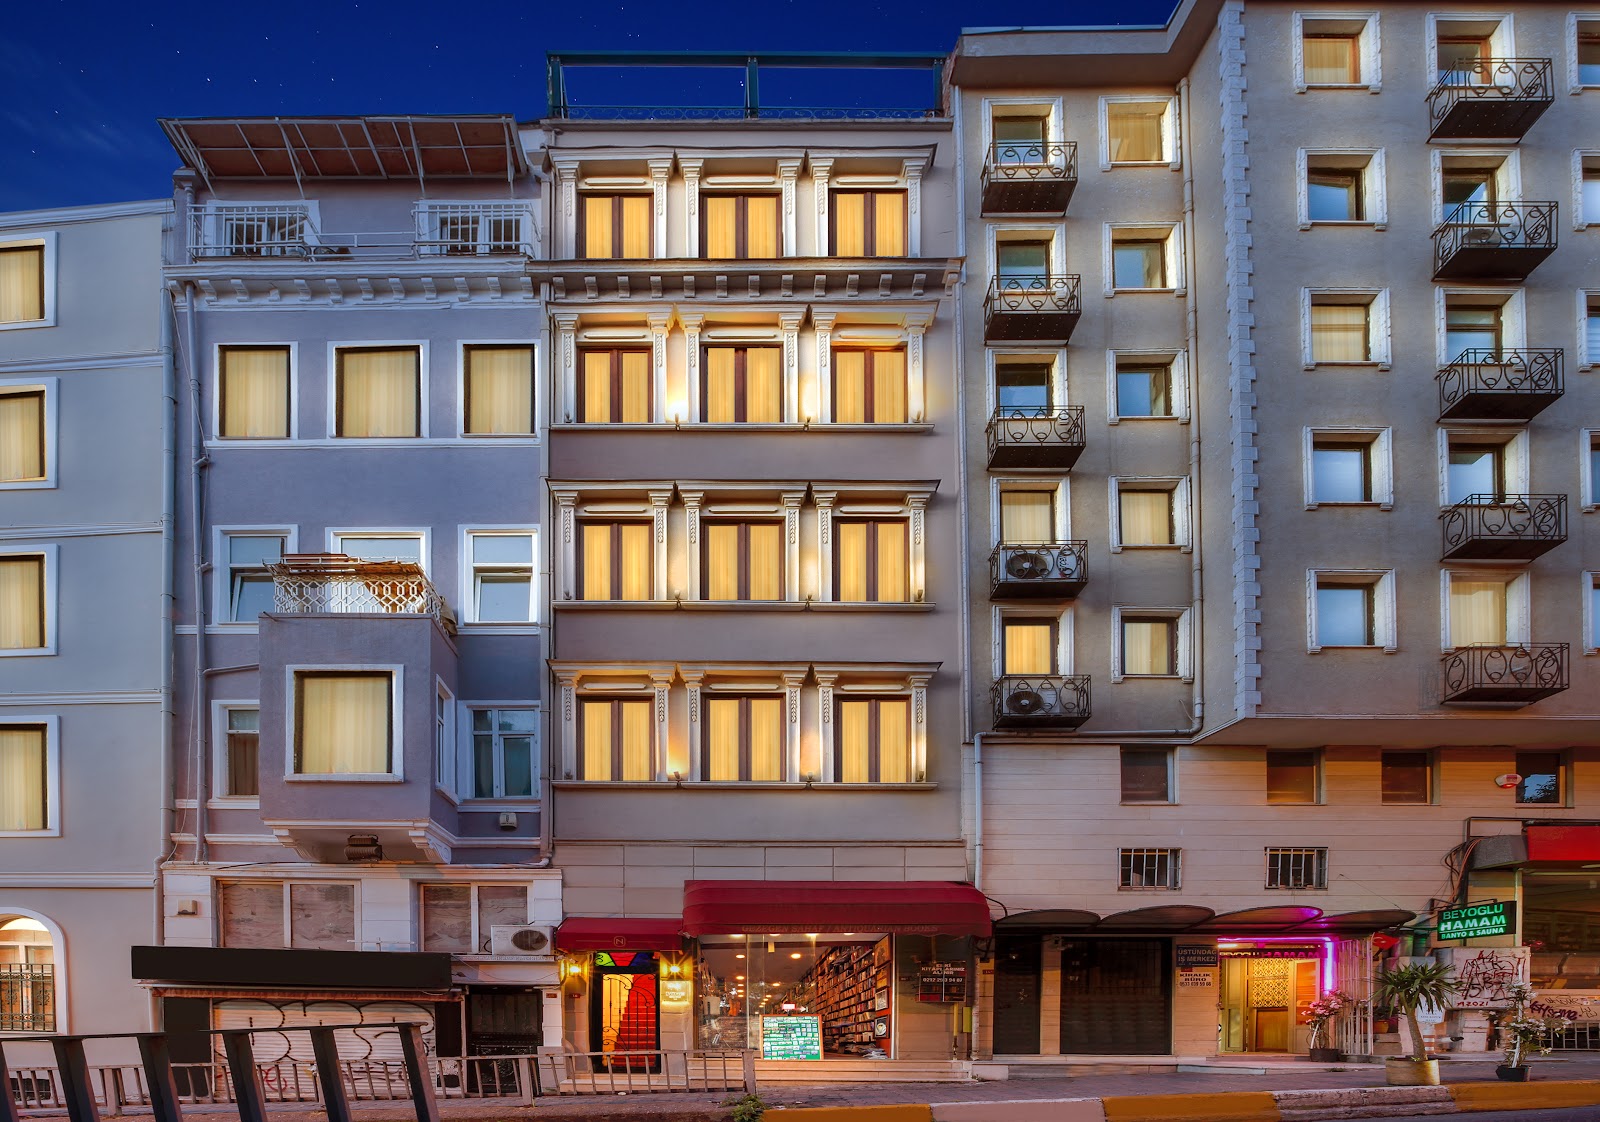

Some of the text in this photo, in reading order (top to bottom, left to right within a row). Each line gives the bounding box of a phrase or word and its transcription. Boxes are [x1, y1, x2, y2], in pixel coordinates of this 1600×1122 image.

[1442, 903, 1503, 920] BEYOGLU
[741, 924, 788, 932] GEZEGEN
[791, 924, 823, 932] SAHAF
[903, 924, 938, 932] BOOKS
[1440, 914, 1506, 931] HAMAM
[1441, 931, 1467, 939] BANYO
[1476, 927, 1505, 936] SAUNA
